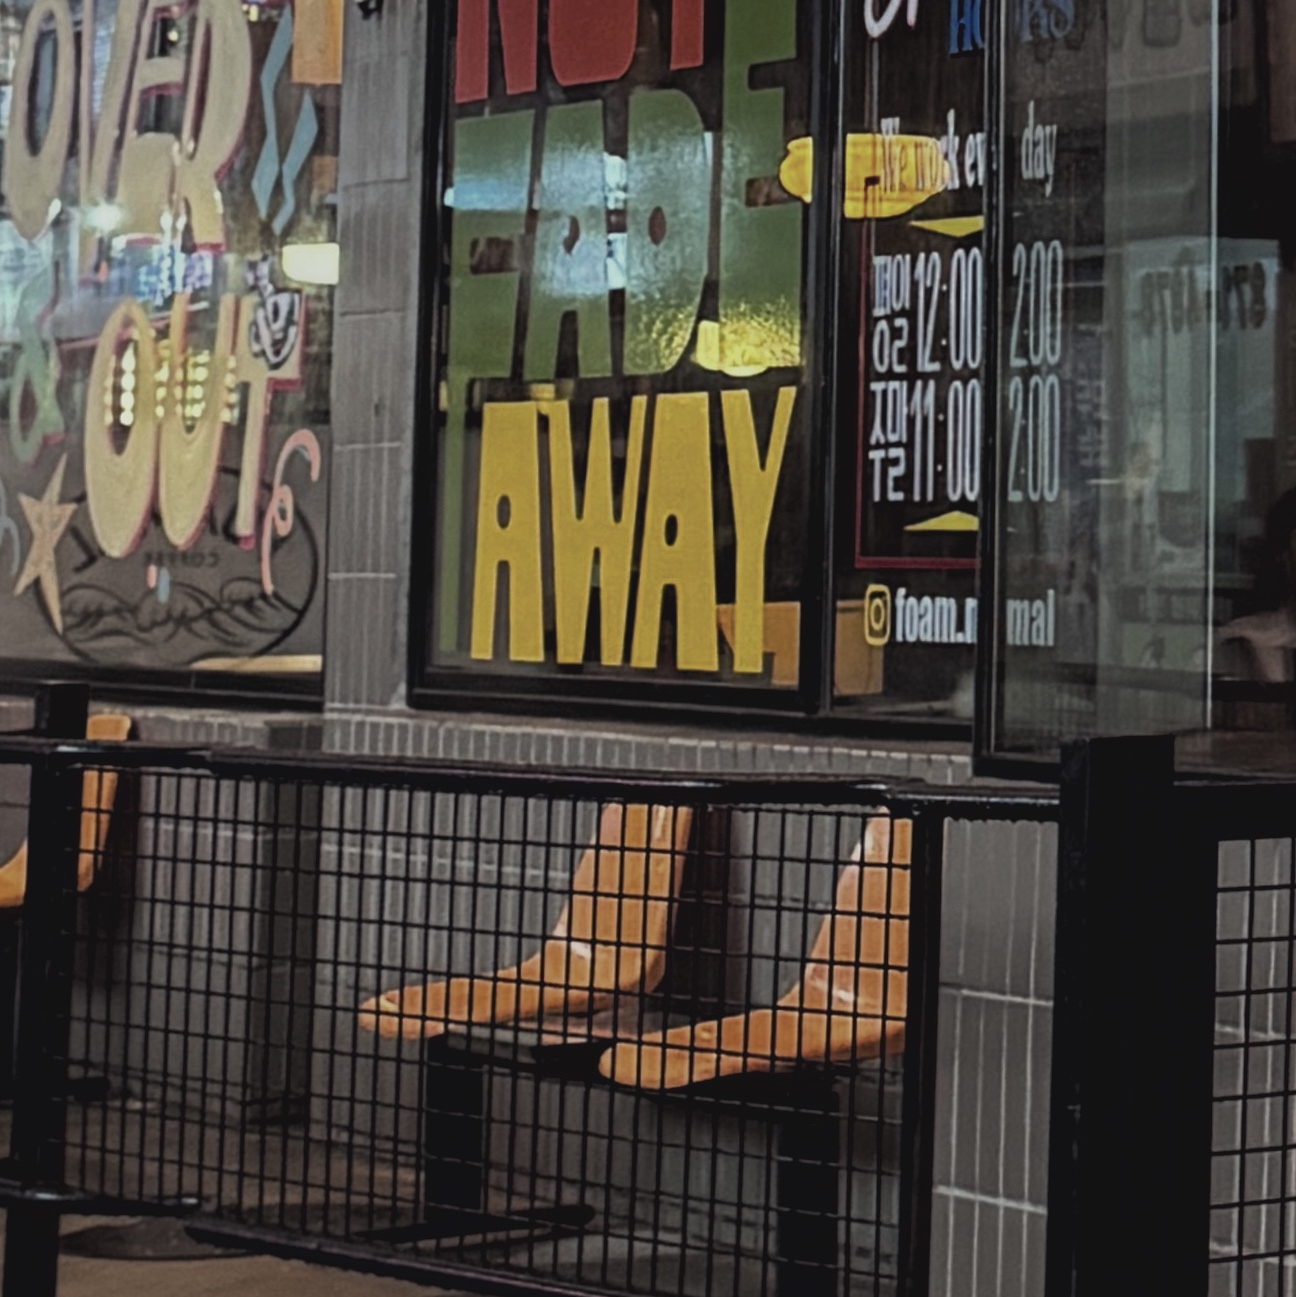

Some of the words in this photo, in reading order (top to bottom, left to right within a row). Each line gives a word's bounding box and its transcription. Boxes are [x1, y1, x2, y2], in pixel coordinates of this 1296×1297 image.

[913, 246, 983, 373] 12:00
[83, 291, 303, 558] OUT
[909, 377, 982, 503] 11:00
[469, 386, 797, 673] AWAY
